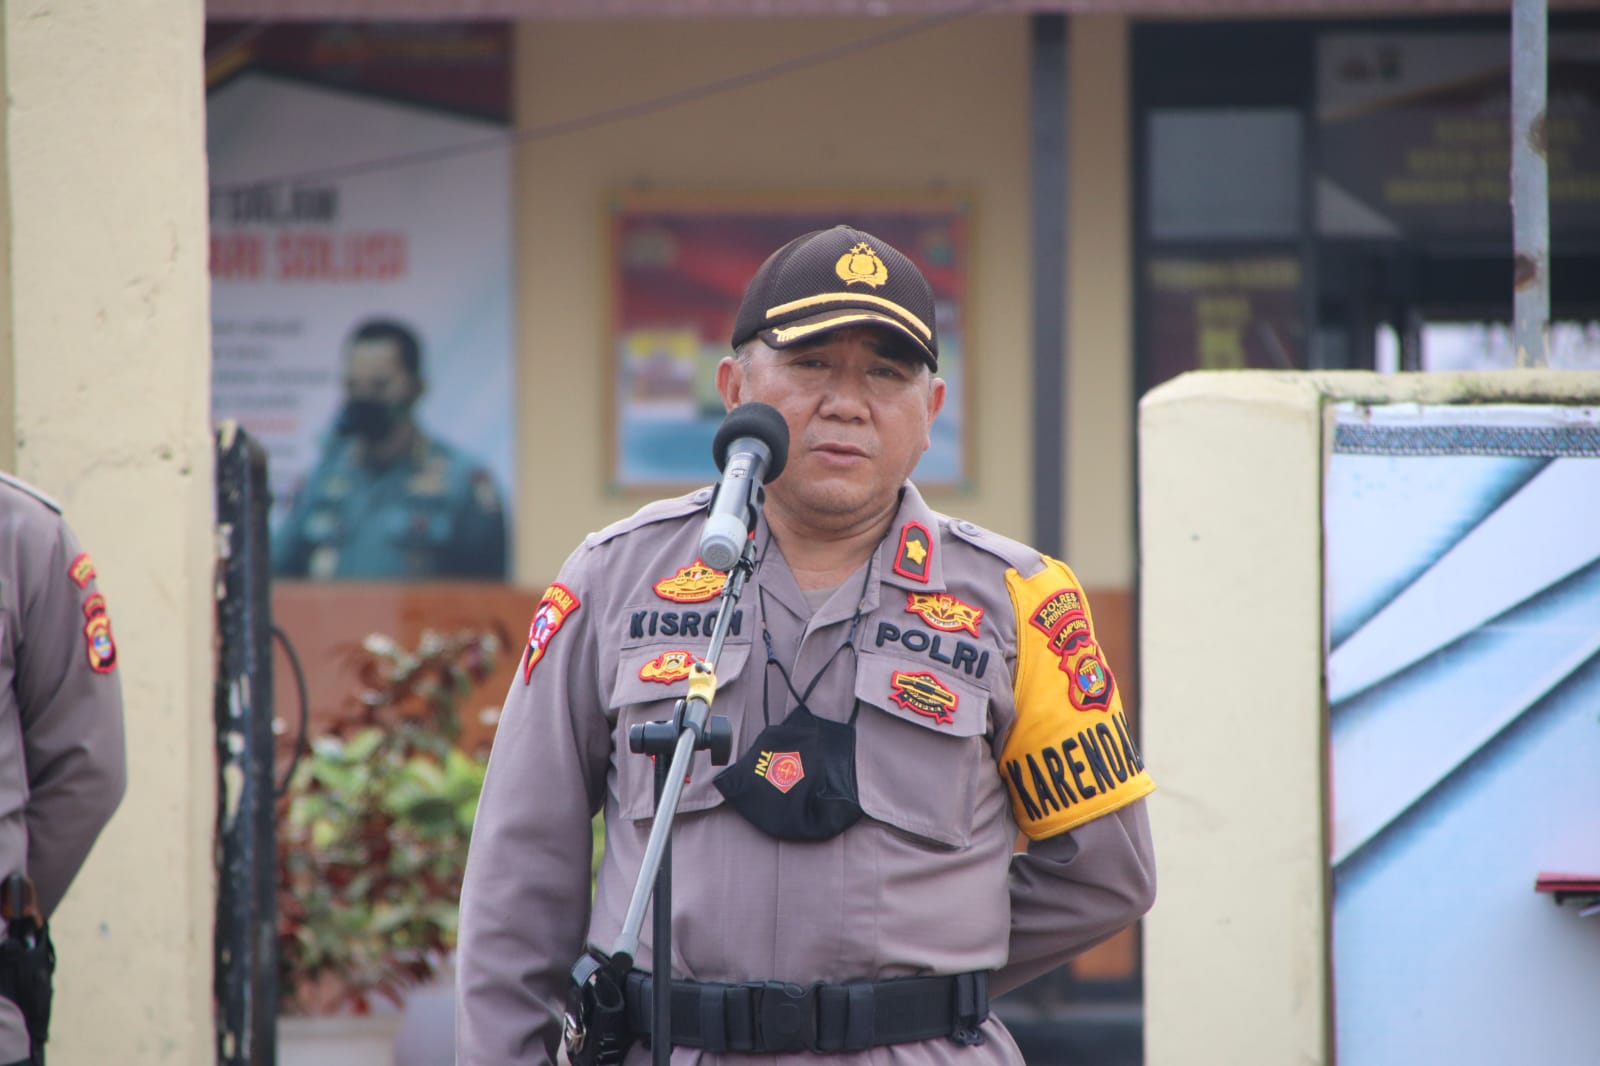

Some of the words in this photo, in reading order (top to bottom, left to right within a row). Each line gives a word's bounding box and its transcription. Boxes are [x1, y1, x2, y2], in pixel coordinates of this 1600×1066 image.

[1040, 592, 1077, 620] POLRES
[1055, 619, 1088, 647] LAMPUNG
[876, 622, 989, 678] POLRI
[754, 750, 773, 777] TNI
